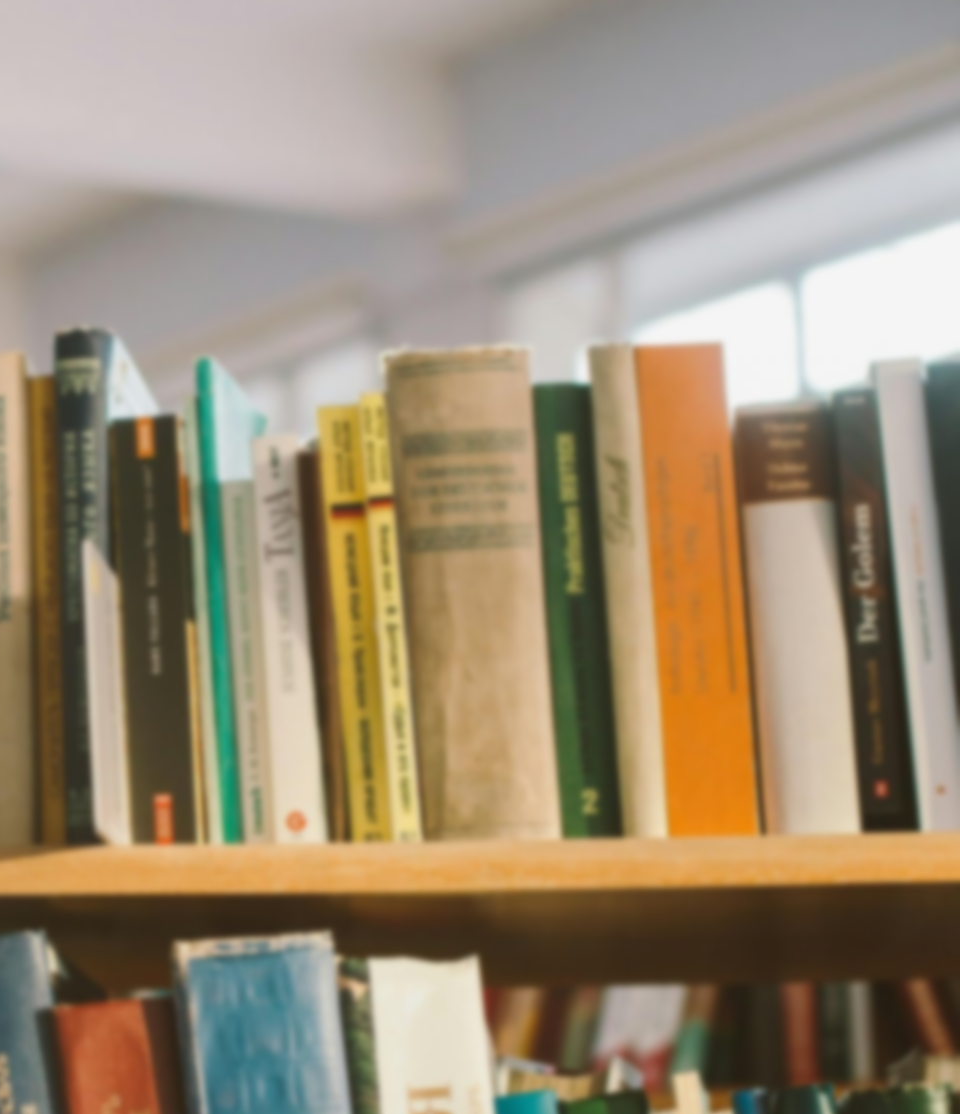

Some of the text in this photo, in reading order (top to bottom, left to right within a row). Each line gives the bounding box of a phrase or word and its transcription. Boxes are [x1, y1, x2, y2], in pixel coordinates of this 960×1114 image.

[81, 428, 97, 492] ЯЗЫКА
[555, 432, 580, 503] DEUTSCH
[64, 503, 78, 523] ПО
[561, 505, 586, 595] Praktisches
[849, 504, 876, 589] Golem
[856, 593, 880, 643] Der
[581, 786, 600, 815] 2
